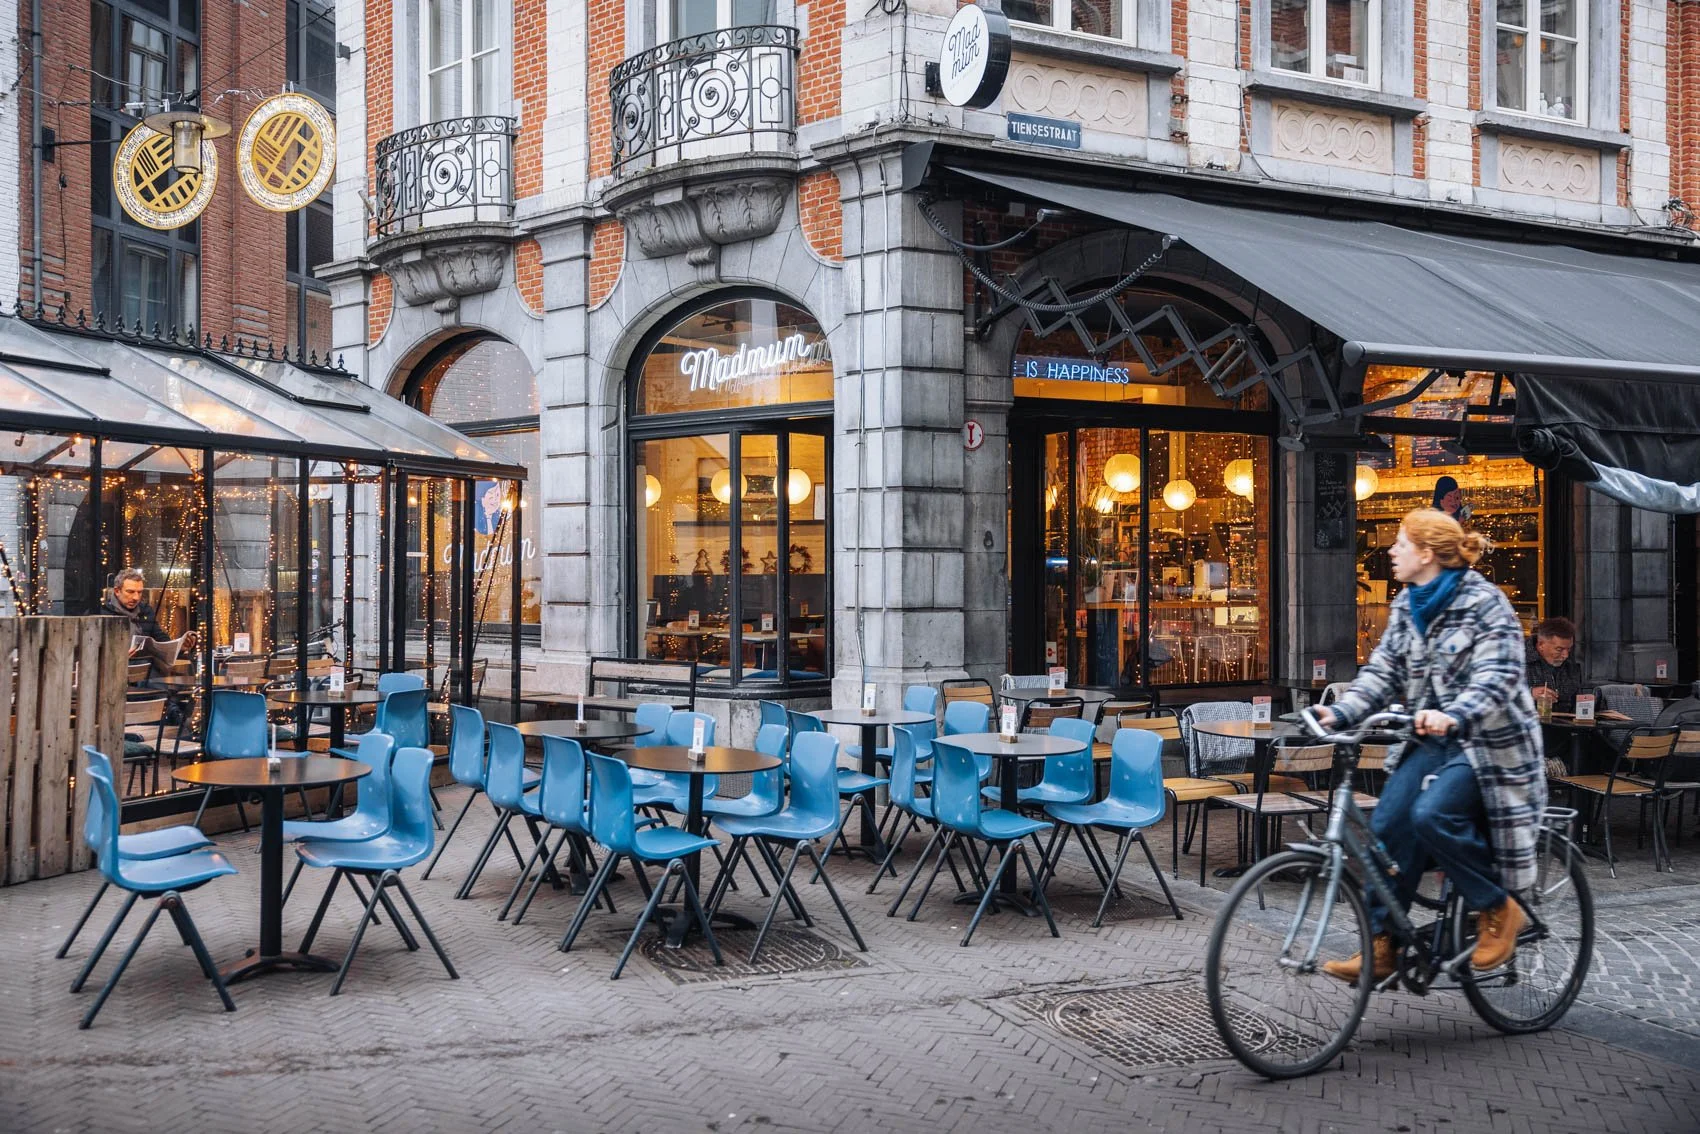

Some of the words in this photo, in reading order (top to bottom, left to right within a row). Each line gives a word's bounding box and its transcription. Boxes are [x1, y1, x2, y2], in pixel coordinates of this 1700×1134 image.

[949, 16, 980, 60] Mad
[952, 43, 980, 79] mum
[1011, 121, 1077, 142] TIENSESTRAAT
[681, 334, 810, 391] Madmum
[1026, 361, 1038, 378] IS
[1047, 362, 1129, 384] HAPPINESS
